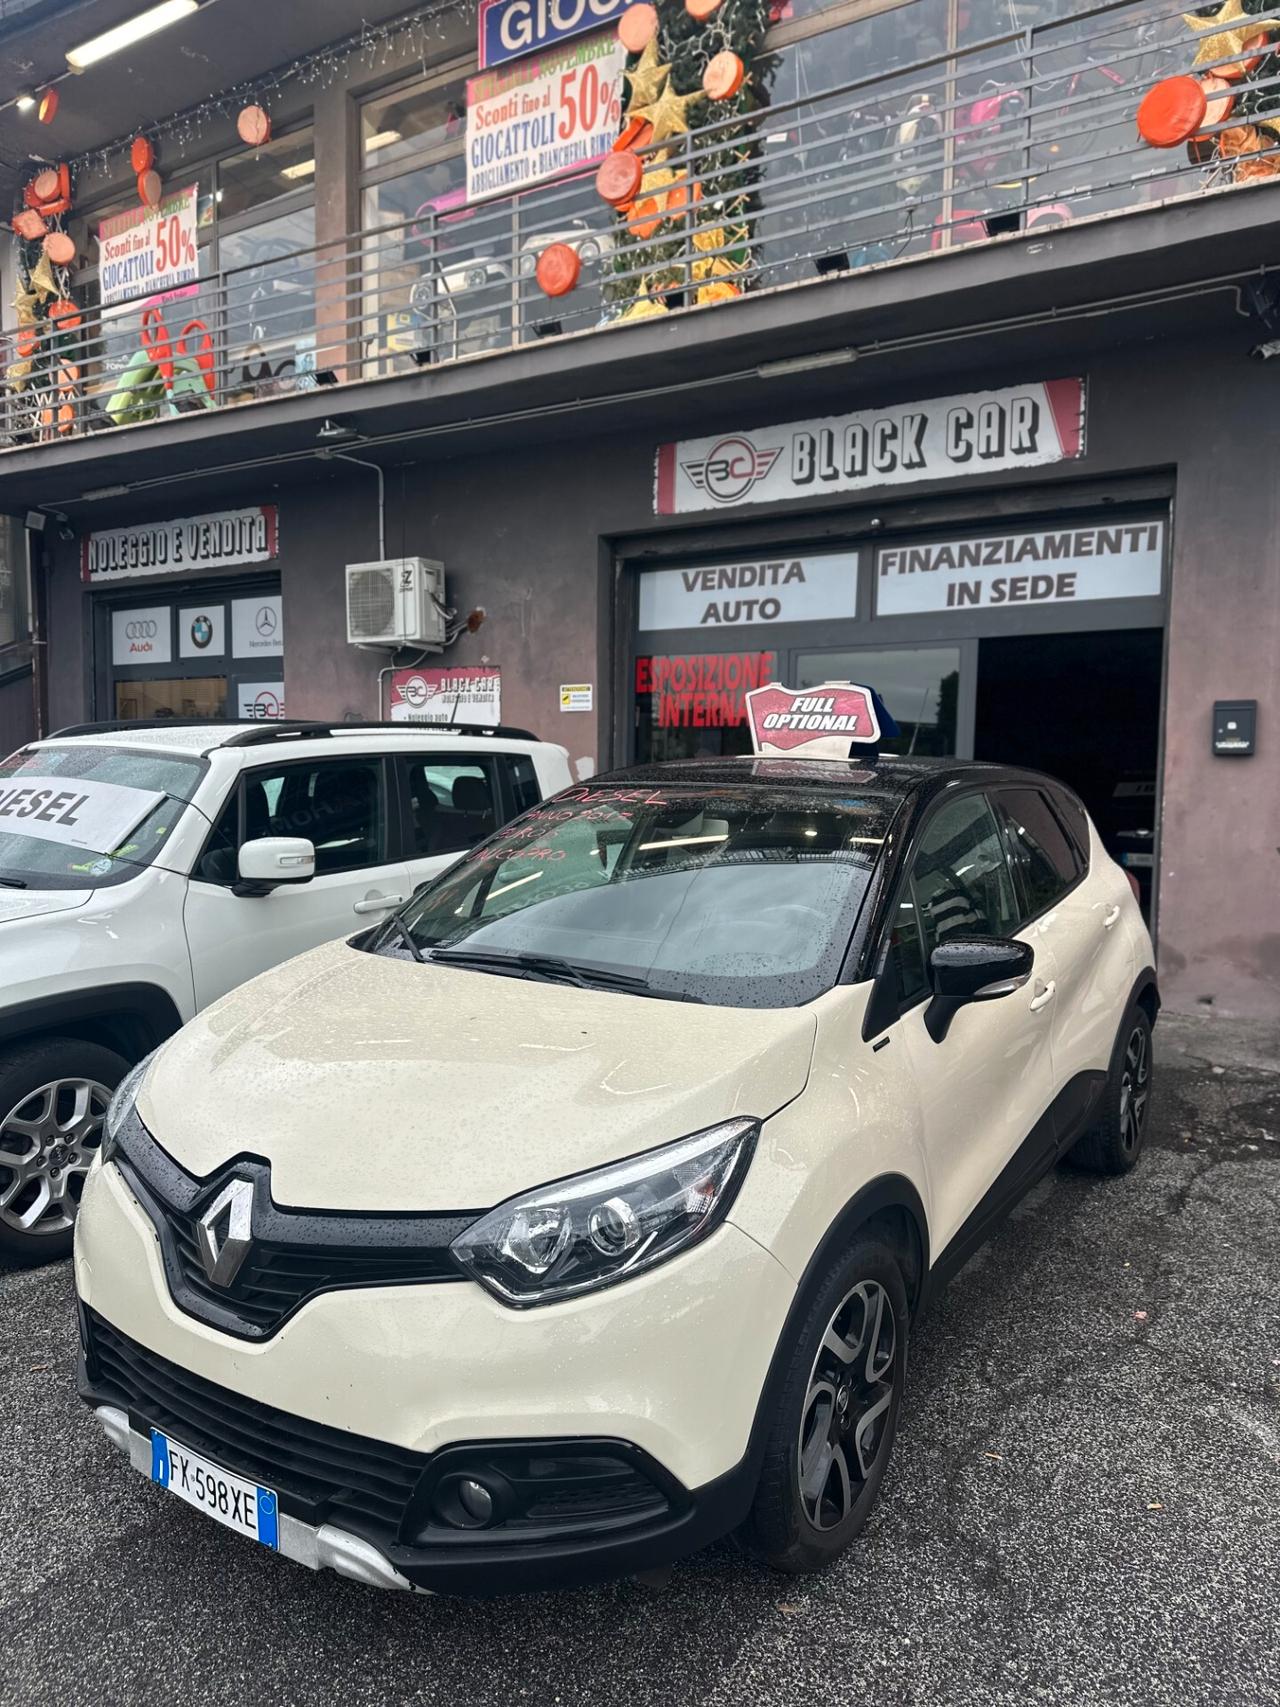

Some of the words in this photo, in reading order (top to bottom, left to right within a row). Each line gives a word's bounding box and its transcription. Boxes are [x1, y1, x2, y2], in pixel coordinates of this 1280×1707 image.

[475, 93, 519, 131] Sconti
[522, 91, 539, 115] fino
[542, 85, 551, 108] al
[558, 64, 620, 140] 50%
[472, 112, 555, 169] GIOCATTOLI
[471, 157, 530, 195] ABBIGLIAMENTO
[532, 161, 537, 175] e
[539, 141, 587, 175] BIANCHERIA
[105, 235, 131, 261] Sconti
[133, 234, 144, 251] fino
[156, 215, 195, 272] 50%
[103, 250, 154, 291] GIOCATTOLI
[791, 412, 929, 484] BLACK
[945, 396, 1040, 463] CAR
[88, 527, 168, 573] NOLEGGIO
[172, 527, 184, 563] E
[187, 514, 268, 561] VENDITA
[880, 525, 1160, 576] FINANZIAMENTI
[681, 560, 806, 593] VENDITA
[946, 579, 982, 607] IN
[990, 572, 1078, 604] SEDE
[701, 598, 782, 624] AUTO
[129, 642, 153, 652] Audi
[440, 677, 472, 693] BLACK
[635, 651, 774, 693] ESPOSIZIONE
[658, 692, 750, 727] INTERNA
[762, 713, 858, 731] OPTIONAL
[790, 697, 836, 713] FULL
[0, 789, 90, 826] IESEL
[552, 787, 667, 805] DIESEL
